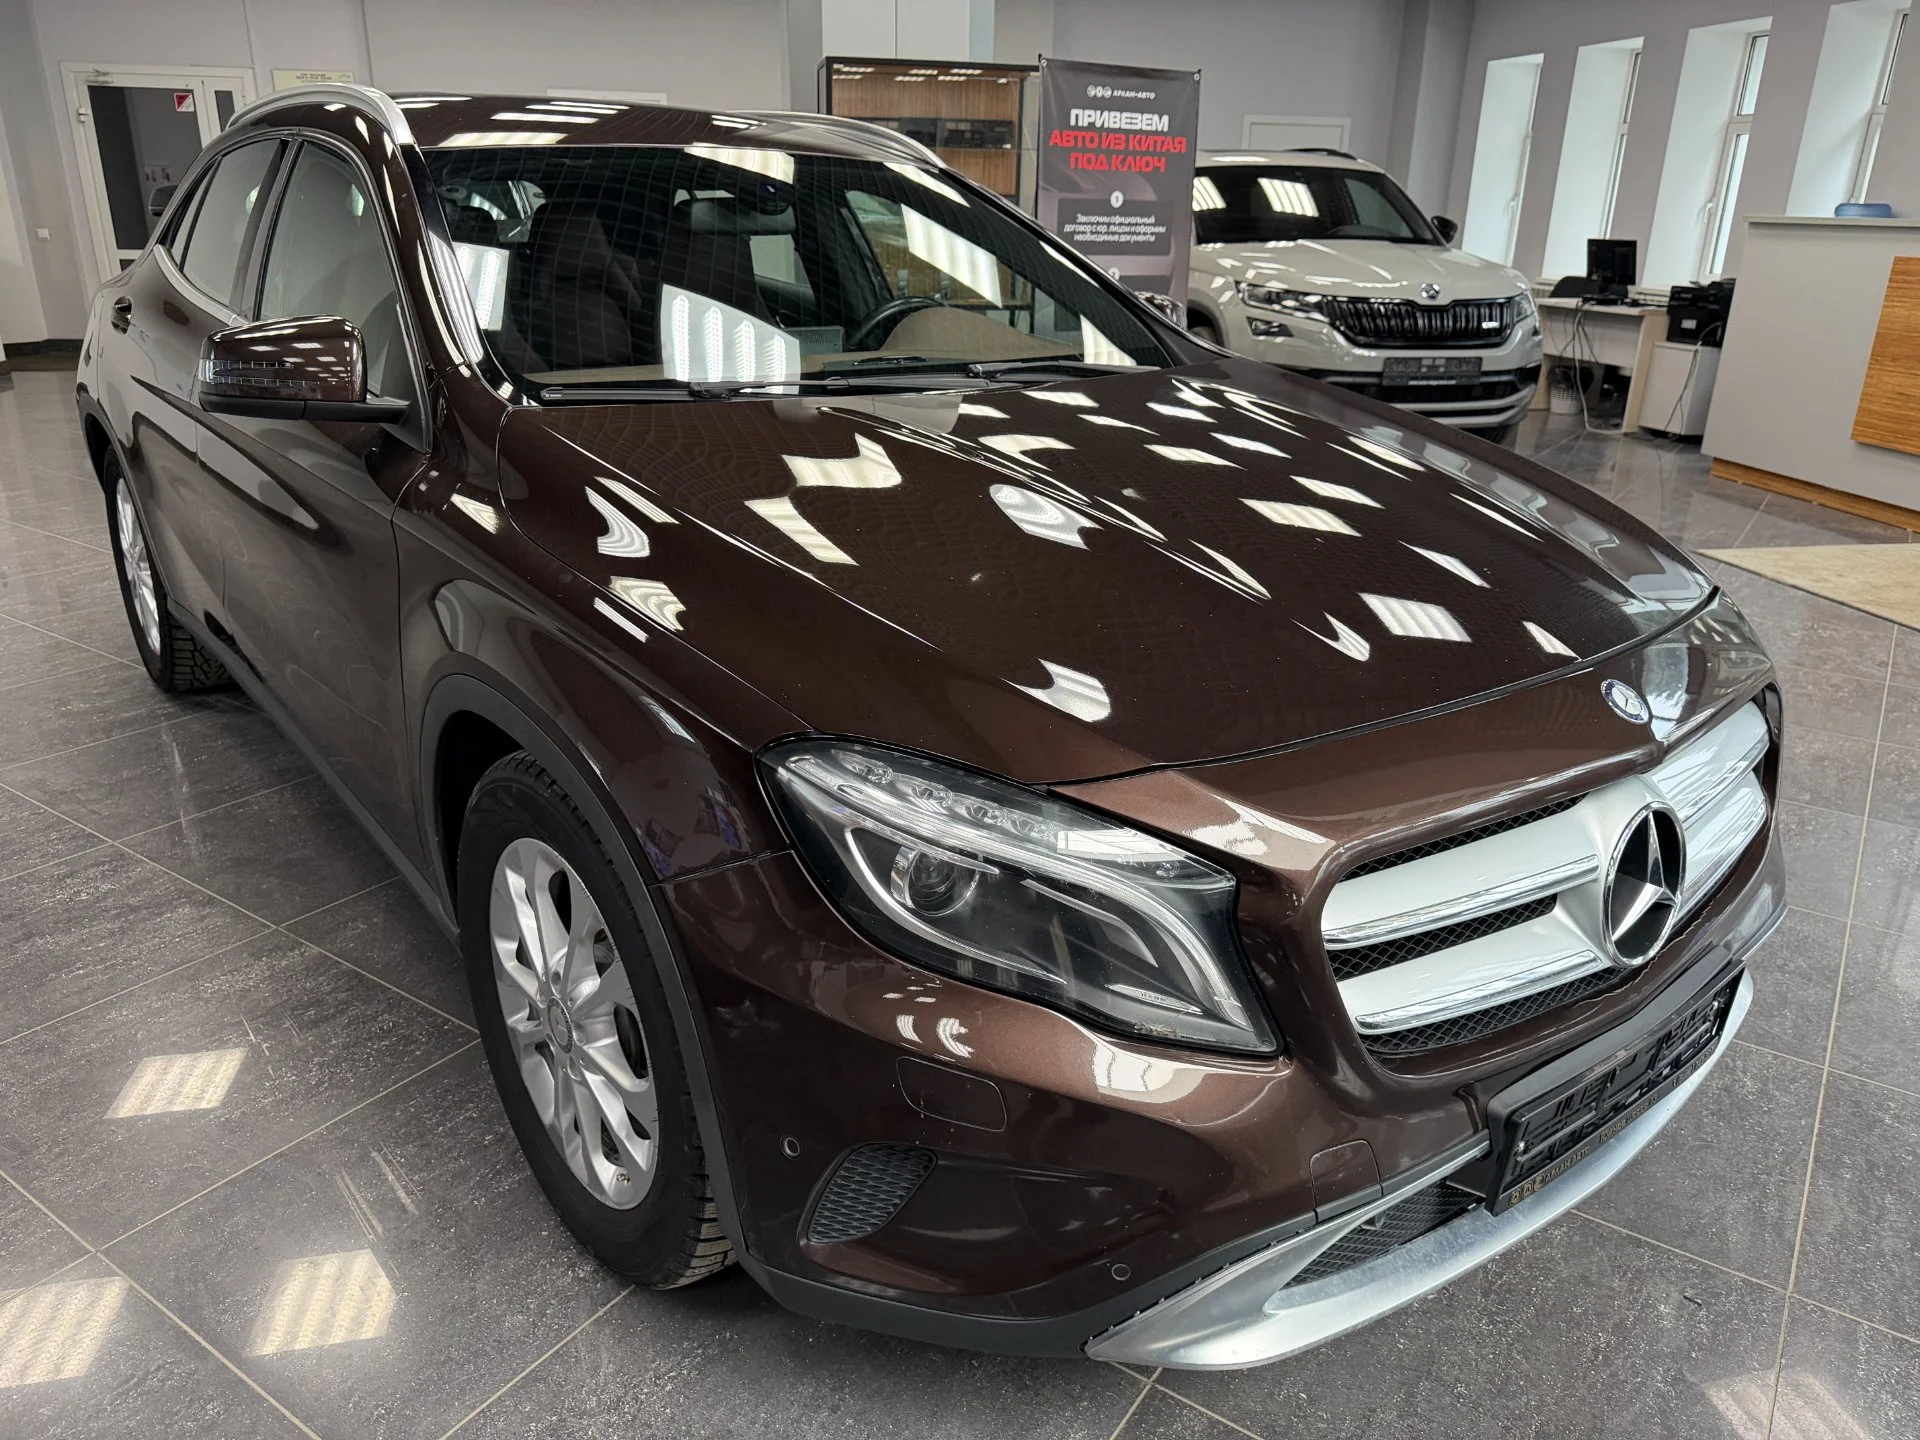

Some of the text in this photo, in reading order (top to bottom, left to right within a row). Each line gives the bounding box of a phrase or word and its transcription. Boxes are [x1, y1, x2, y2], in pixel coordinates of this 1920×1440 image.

[1070, 108, 1169, 132] ПРИВЕЗЕМ
[1049, 130, 1187, 153] АВТО ИЗ КИТАЯ
[1070, 152, 1166, 173] ПОД КЛЮЧ
[1076, 213, 1156, 225] Заключим официальный
[1064, 224, 1091, 233] договор
[1074, 232, 1156, 244] необходимые документы
